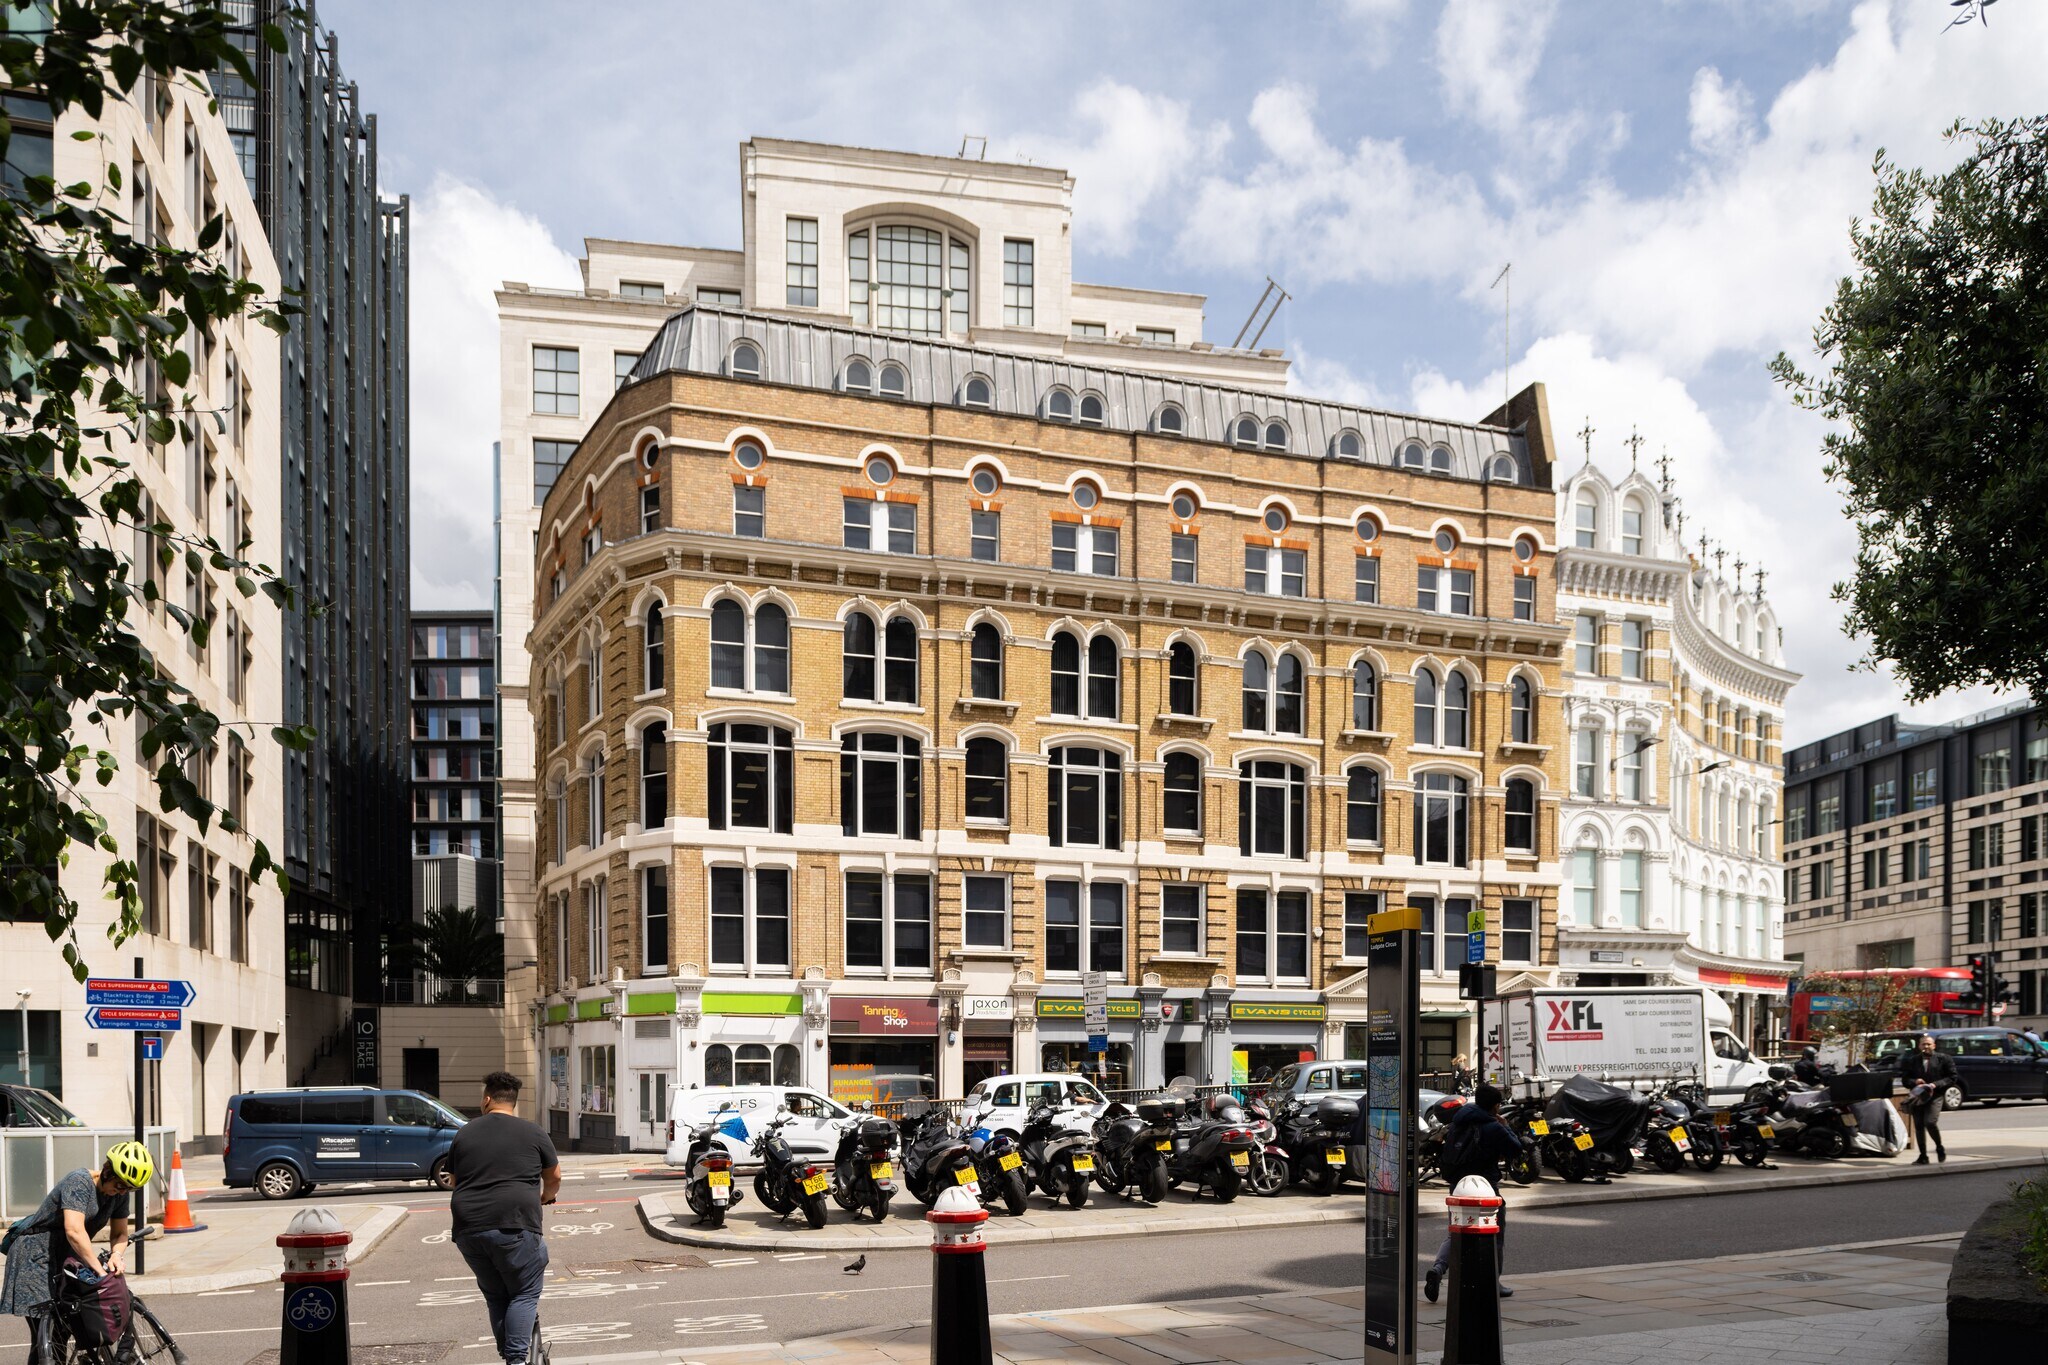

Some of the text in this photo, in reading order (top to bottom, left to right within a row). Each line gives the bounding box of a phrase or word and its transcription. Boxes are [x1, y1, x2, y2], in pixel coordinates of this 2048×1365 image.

[862, 1005, 898, 1018] Tanning
[1546, 1000, 1603, 1031] XFL
[883, 1016, 908, 1028] Shop
[356, 1042, 366, 1069] PLACE
[366, 1042, 374, 1067] FLEET
[716, 1187, 725, 1196] L
[966, 1184, 976, 1192] L
